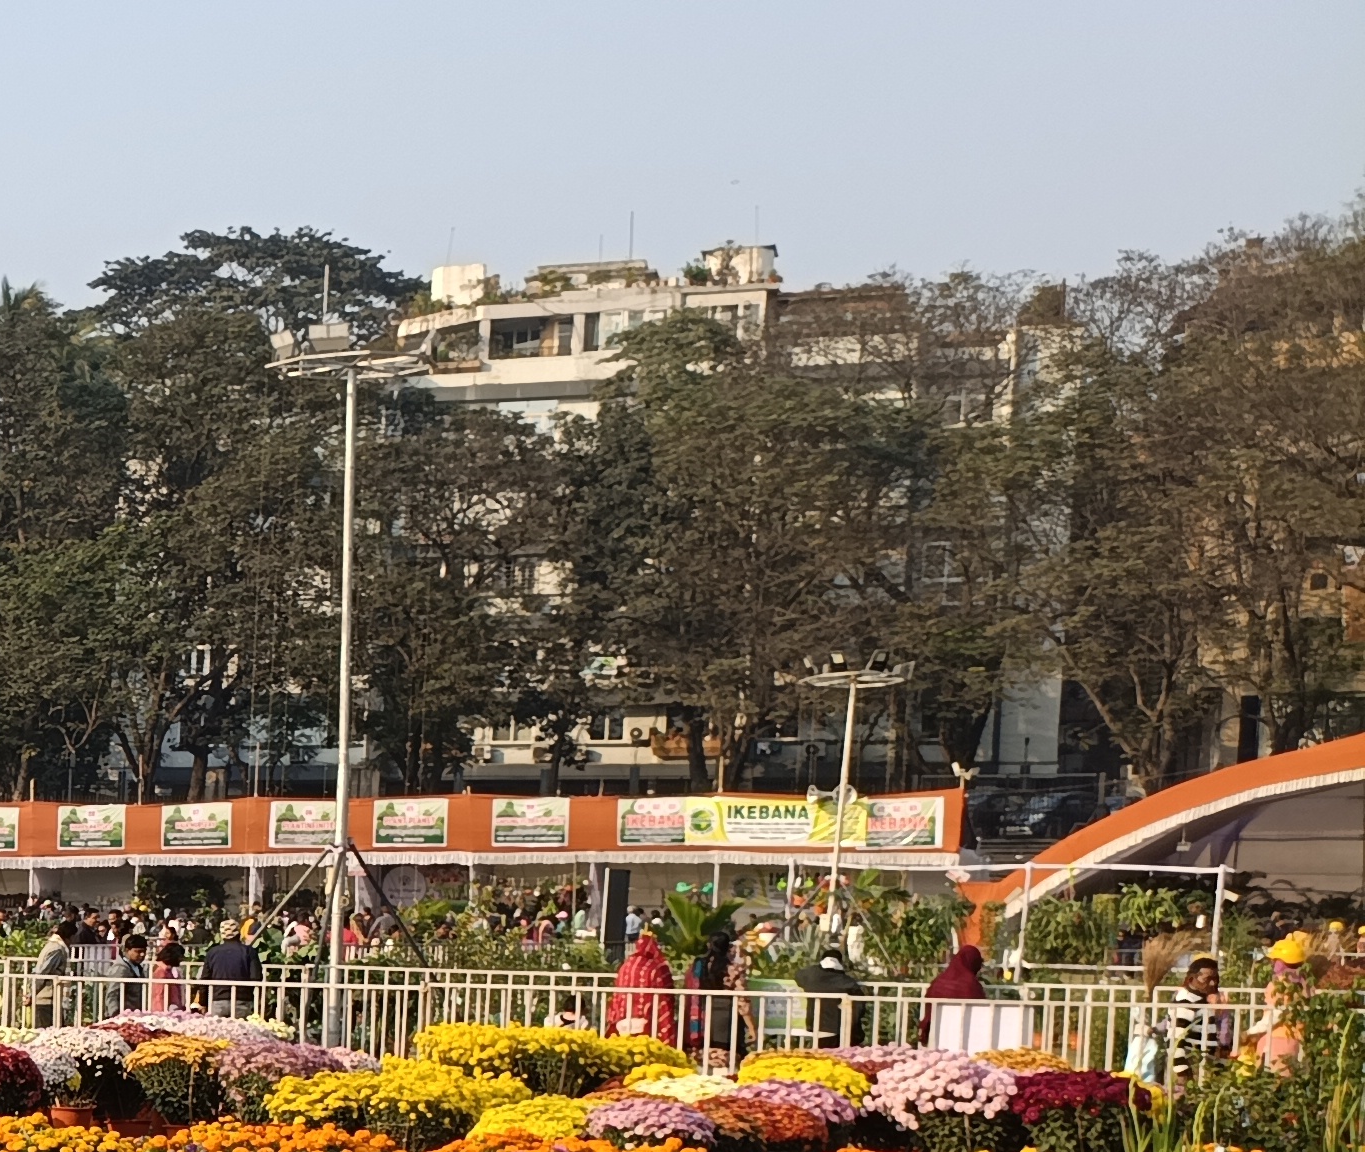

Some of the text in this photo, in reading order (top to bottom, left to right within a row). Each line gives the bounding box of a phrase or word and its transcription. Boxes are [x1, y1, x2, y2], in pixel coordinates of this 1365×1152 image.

[727, 804, 809, 820] IKEBANA
[626, 815, 685, 827] IKEBANA
[870, 816, 928, 829] KEBANA
